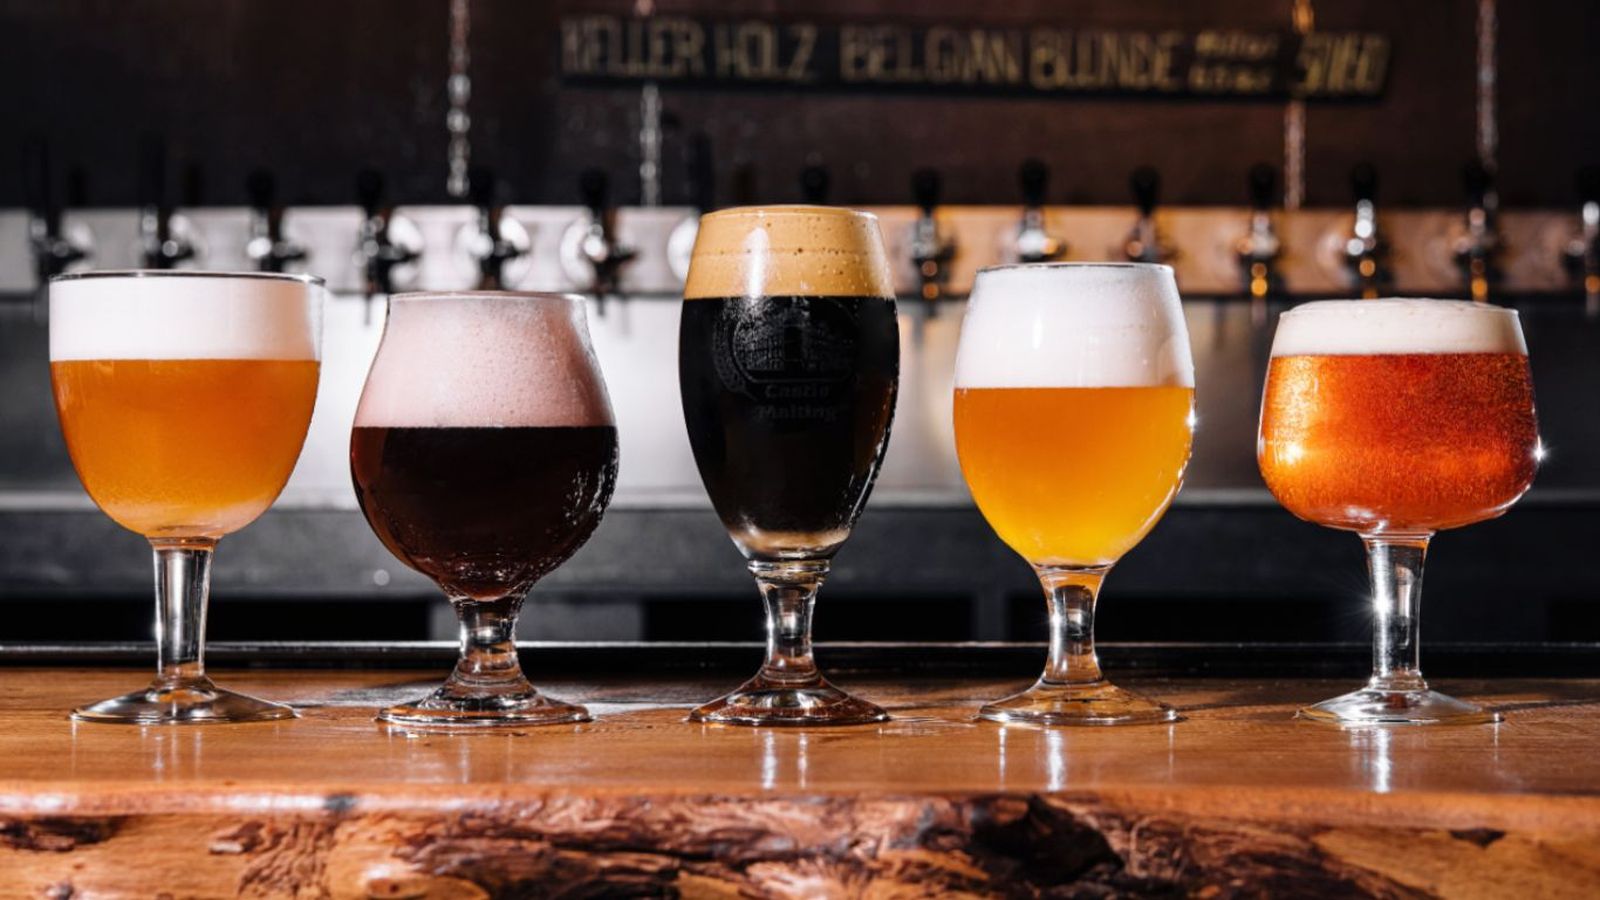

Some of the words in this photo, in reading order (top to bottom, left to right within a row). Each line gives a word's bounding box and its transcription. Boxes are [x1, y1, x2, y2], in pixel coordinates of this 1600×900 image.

[560, 16, 706, 77] KELLER
[713, 20, 820, 81] HOLZ
[839, 24, 1023, 84] BELGIAN
